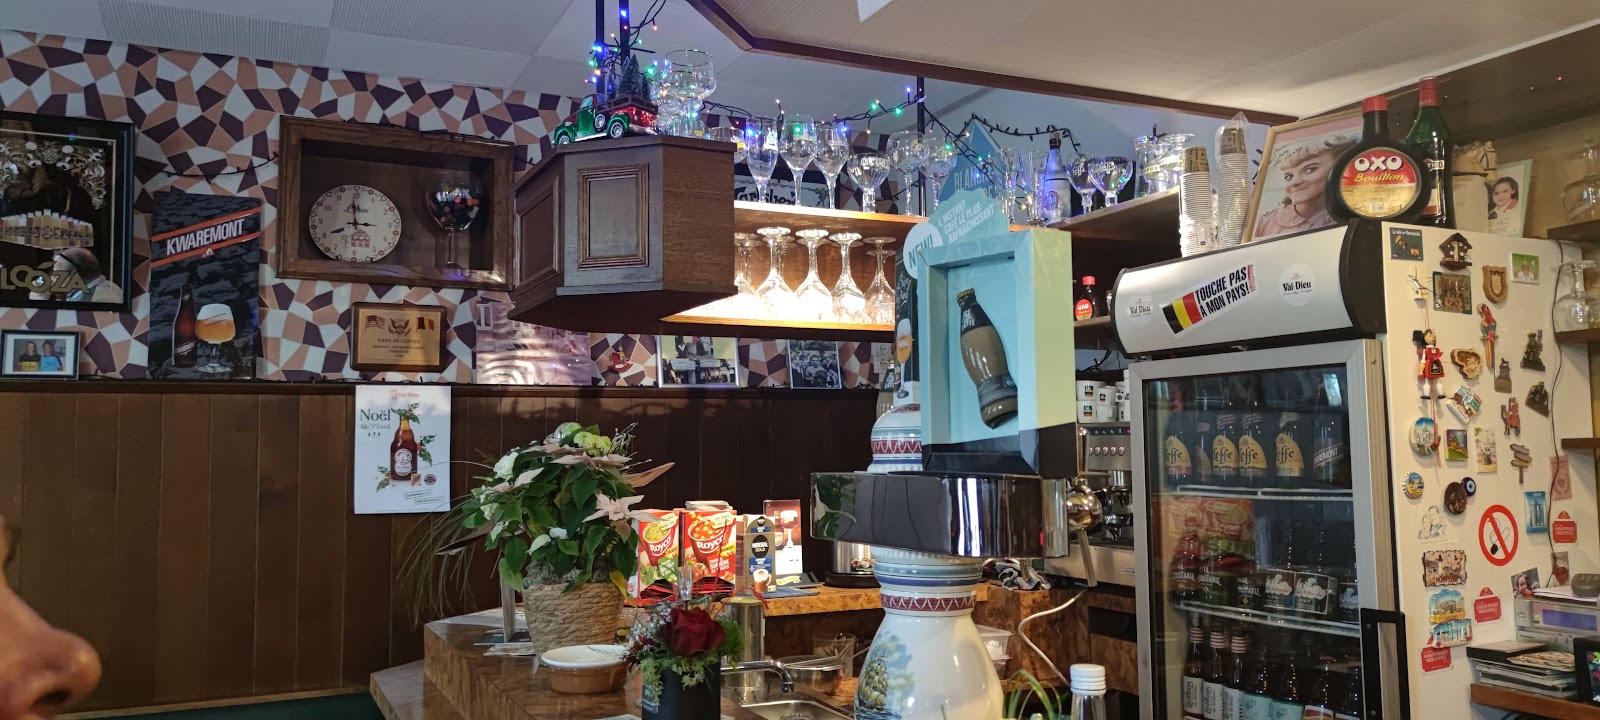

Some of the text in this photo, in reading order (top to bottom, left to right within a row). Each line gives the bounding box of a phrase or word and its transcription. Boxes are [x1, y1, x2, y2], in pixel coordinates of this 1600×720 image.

[1354, 155, 1402, 172] OXO
[1354, 173, 1404, 182] Bouillon
[966, 202, 981, 219] PLUS
[166, 219, 244, 255] KWAREMONT
[1195, 276, 1227, 305] TOUCHE
[1229, 267, 1247, 287] PAS
[1206, 294, 1226, 315] MON
[1225, 281, 1250, 304] PAYS!
[360, 409, 391, 421] Noël
[650, 536, 671, 553] Royco
